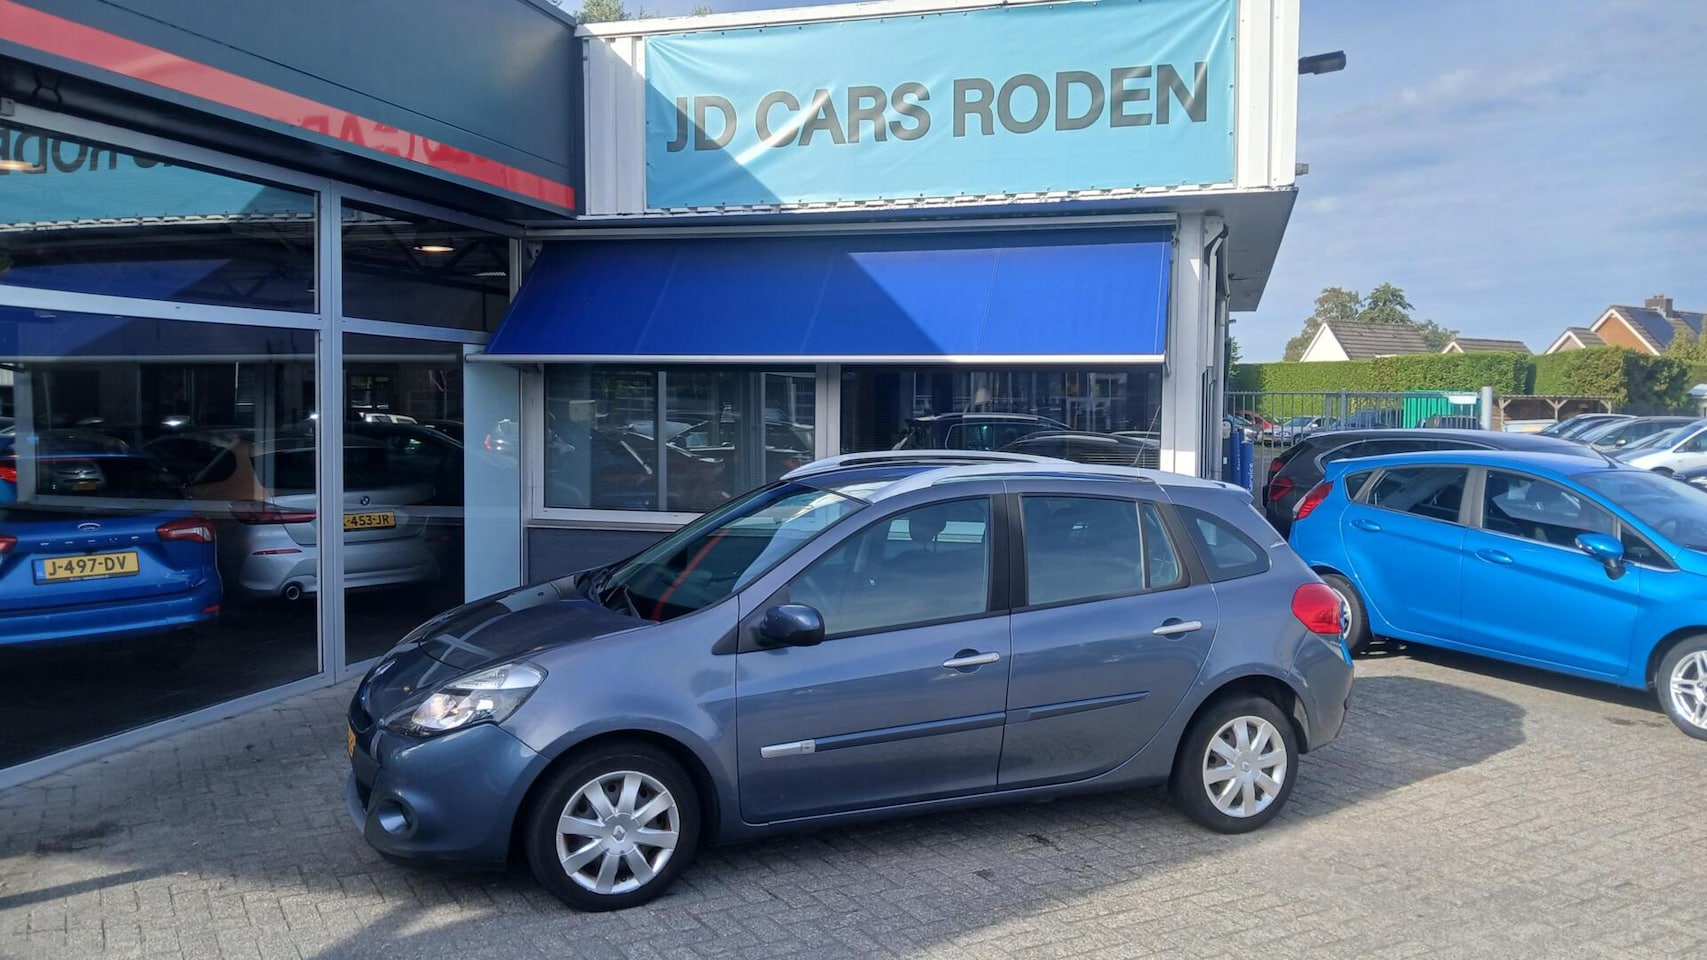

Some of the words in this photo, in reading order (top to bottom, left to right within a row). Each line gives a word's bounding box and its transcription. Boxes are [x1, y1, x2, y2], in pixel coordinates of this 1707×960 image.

[667, 95, 737, 153] JD
[755, 82, 931, 148] CARS
[953, 61, 1208, 138] RODEN
[344, 514, 390, 527] -453-JR
[48, 556, 127, 576] J-497-DV
